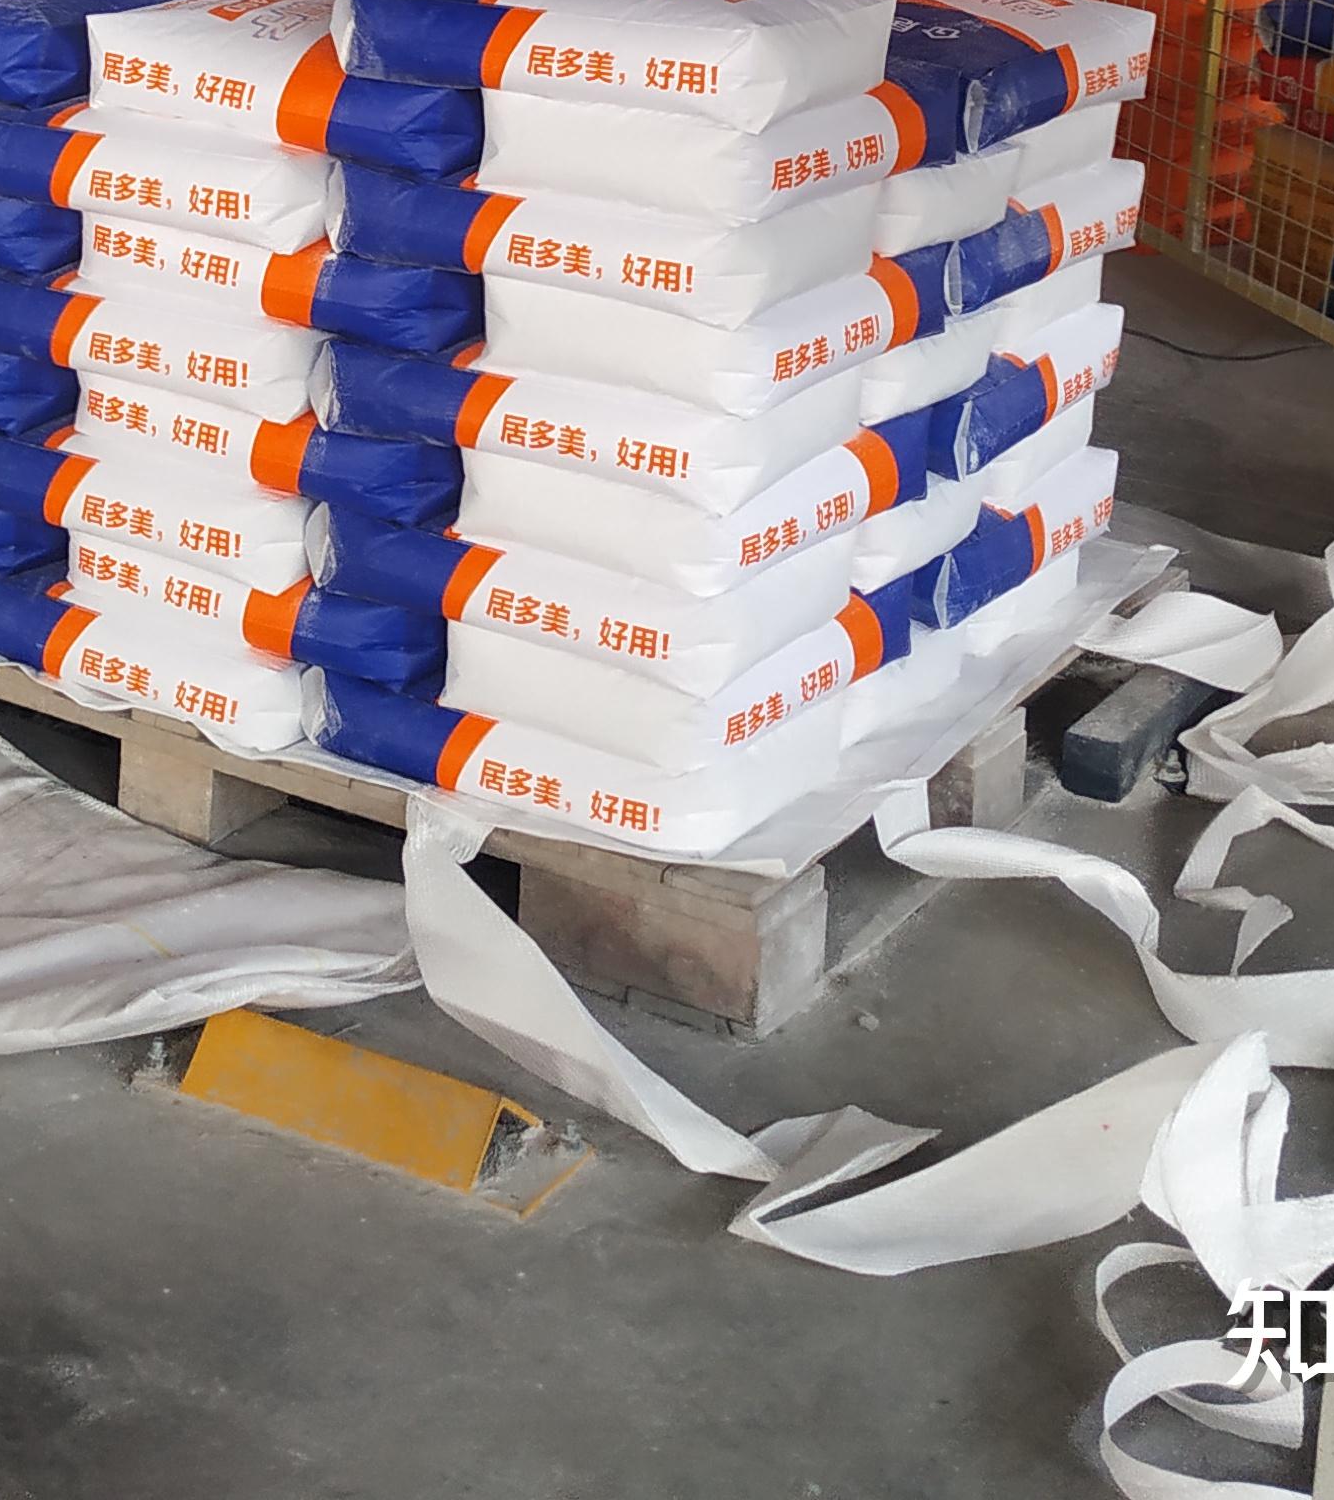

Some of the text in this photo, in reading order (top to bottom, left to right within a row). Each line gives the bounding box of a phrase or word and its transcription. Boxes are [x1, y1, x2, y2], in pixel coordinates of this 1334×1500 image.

[103, 51, 256, 111] 居多美，好用!
[528, 44, 720, 94] 居多美，好用!
[771, 134, 887, 191] 居多美，好用!
[89, 170, 251, 221] 居多美，好用!
[93, 224, 240, 286] 居多美，好用!
[507, 234, 695, 293] 居多美，好用!
[88, 332, 249, 389] 居多美，好用!
[772, 314, 881, 382] 居多美，好用!
[87, 389, 231, 455] 居多美，好用!
[500, 414, 690, 479] 居多美，好用!
[82, 494, 242, 558] 居多美，好用!
[739, 491, 855, 568] 居多美，好用!
[77, 547, 222, 618] 居多美，好用!
[485, 588, 670, 660] 居多美，好用!
[80, 648, 239, 724] 居多美，好用!
[723, 660, 842, 746] 居多美，好用!
[479, 759, 660, 832] 居多美，好用!
